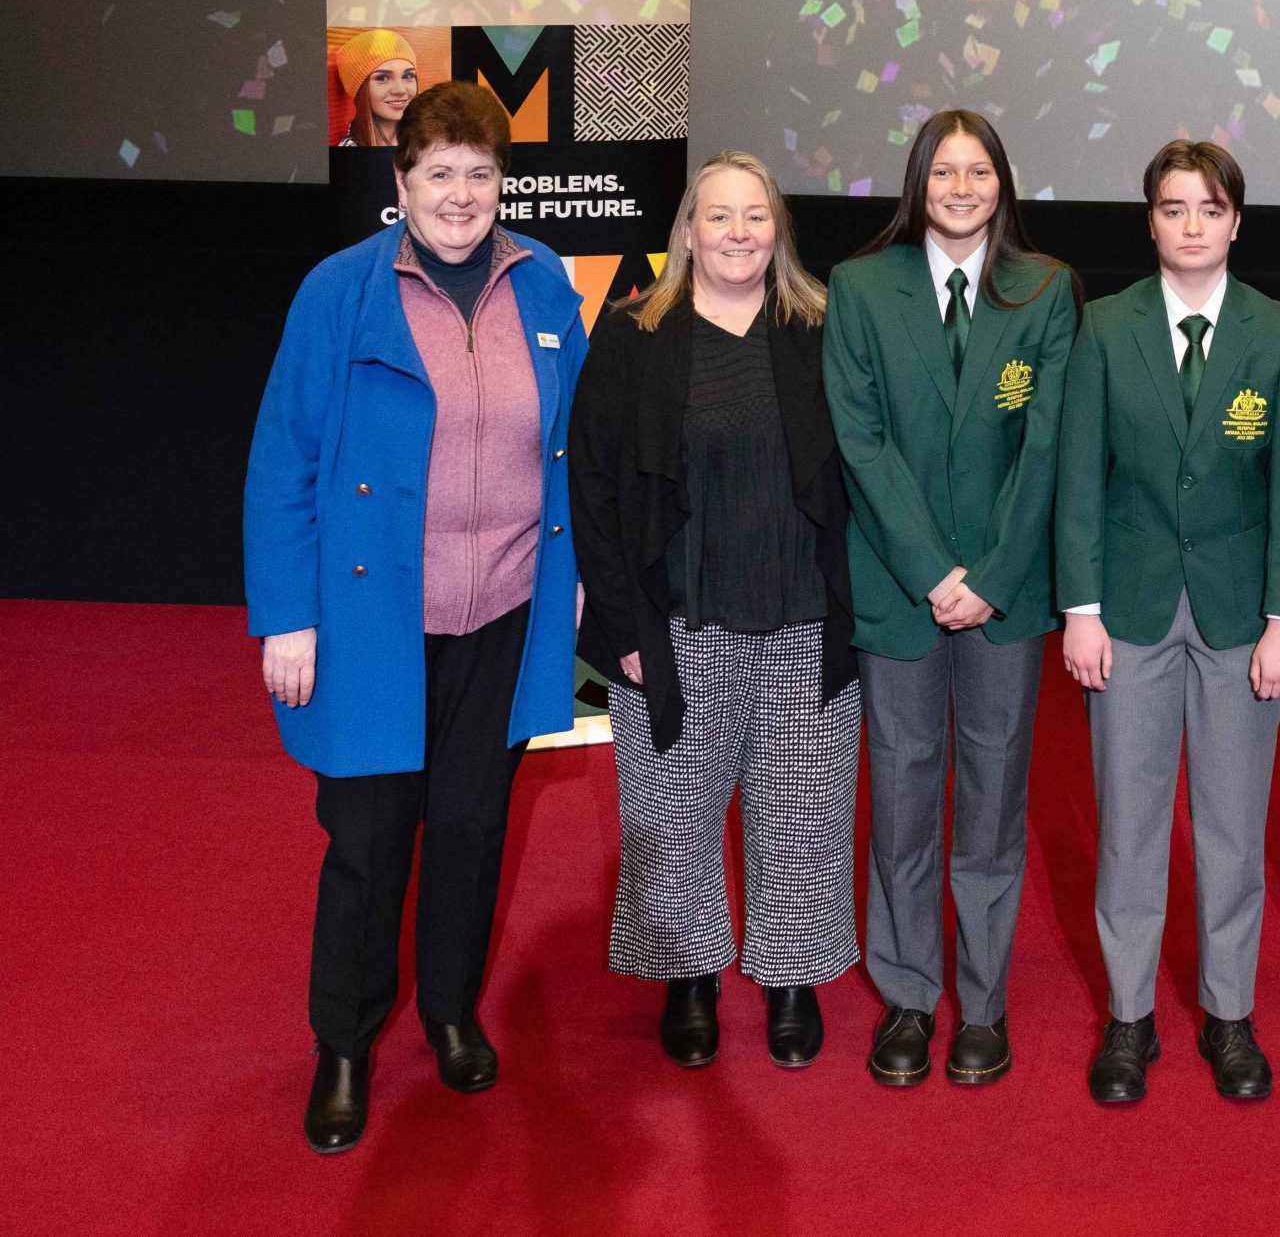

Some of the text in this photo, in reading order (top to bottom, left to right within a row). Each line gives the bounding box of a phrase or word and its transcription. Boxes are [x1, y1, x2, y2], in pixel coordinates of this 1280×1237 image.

[502, 174, 625, 195] ROBLEMS.
[500, 199, 643, 220] HE FUTURE.
